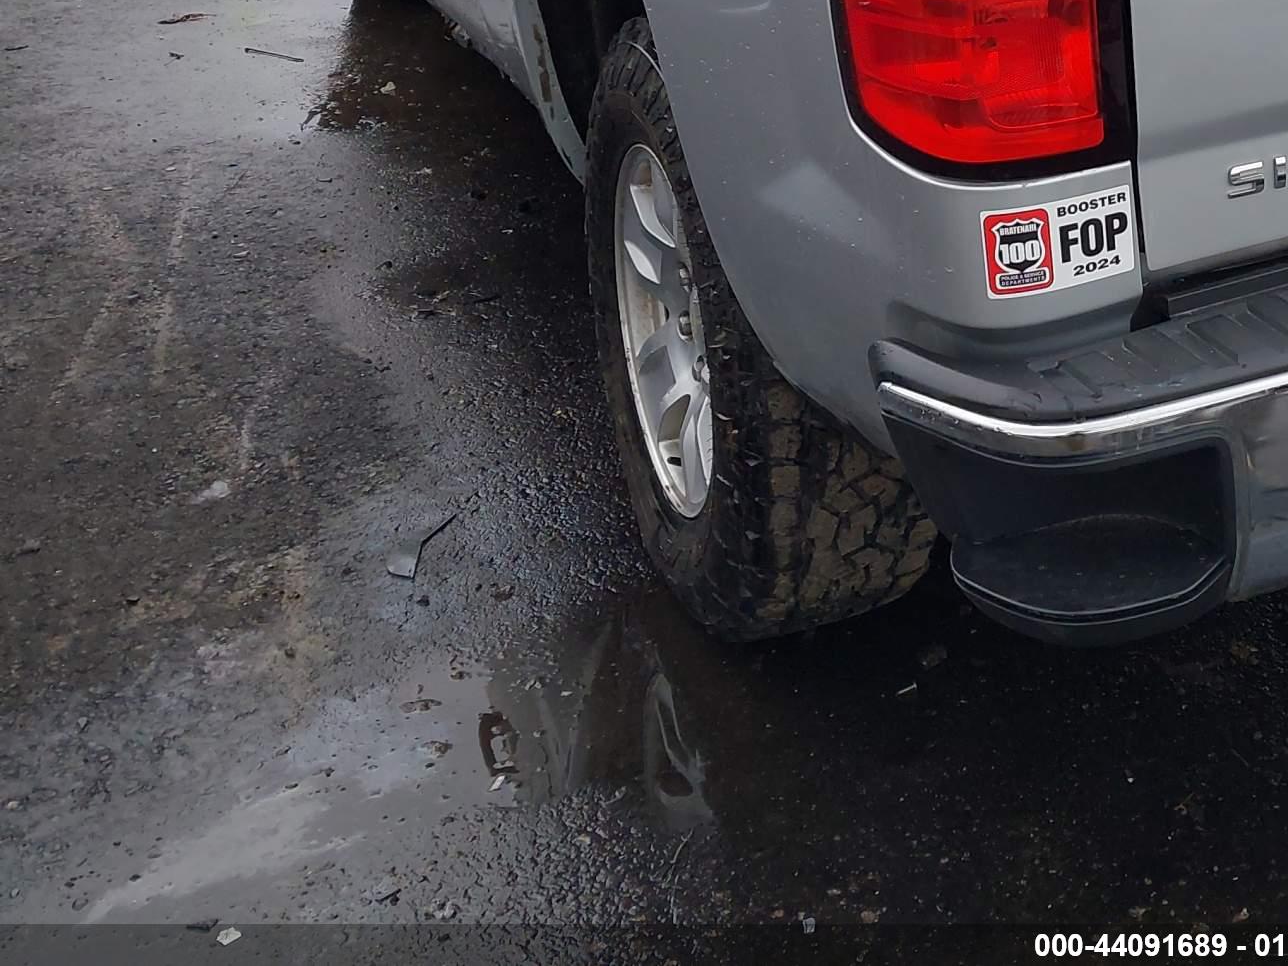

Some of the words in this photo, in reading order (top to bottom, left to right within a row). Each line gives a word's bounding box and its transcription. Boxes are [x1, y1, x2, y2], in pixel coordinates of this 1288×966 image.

[1056, 192, 1126, 218] BOOSTER
[1058, 211, 1129, 264] FOP
[999, 239, 1041, 265] 100
[1073, 254, 1121, 277] 2024
